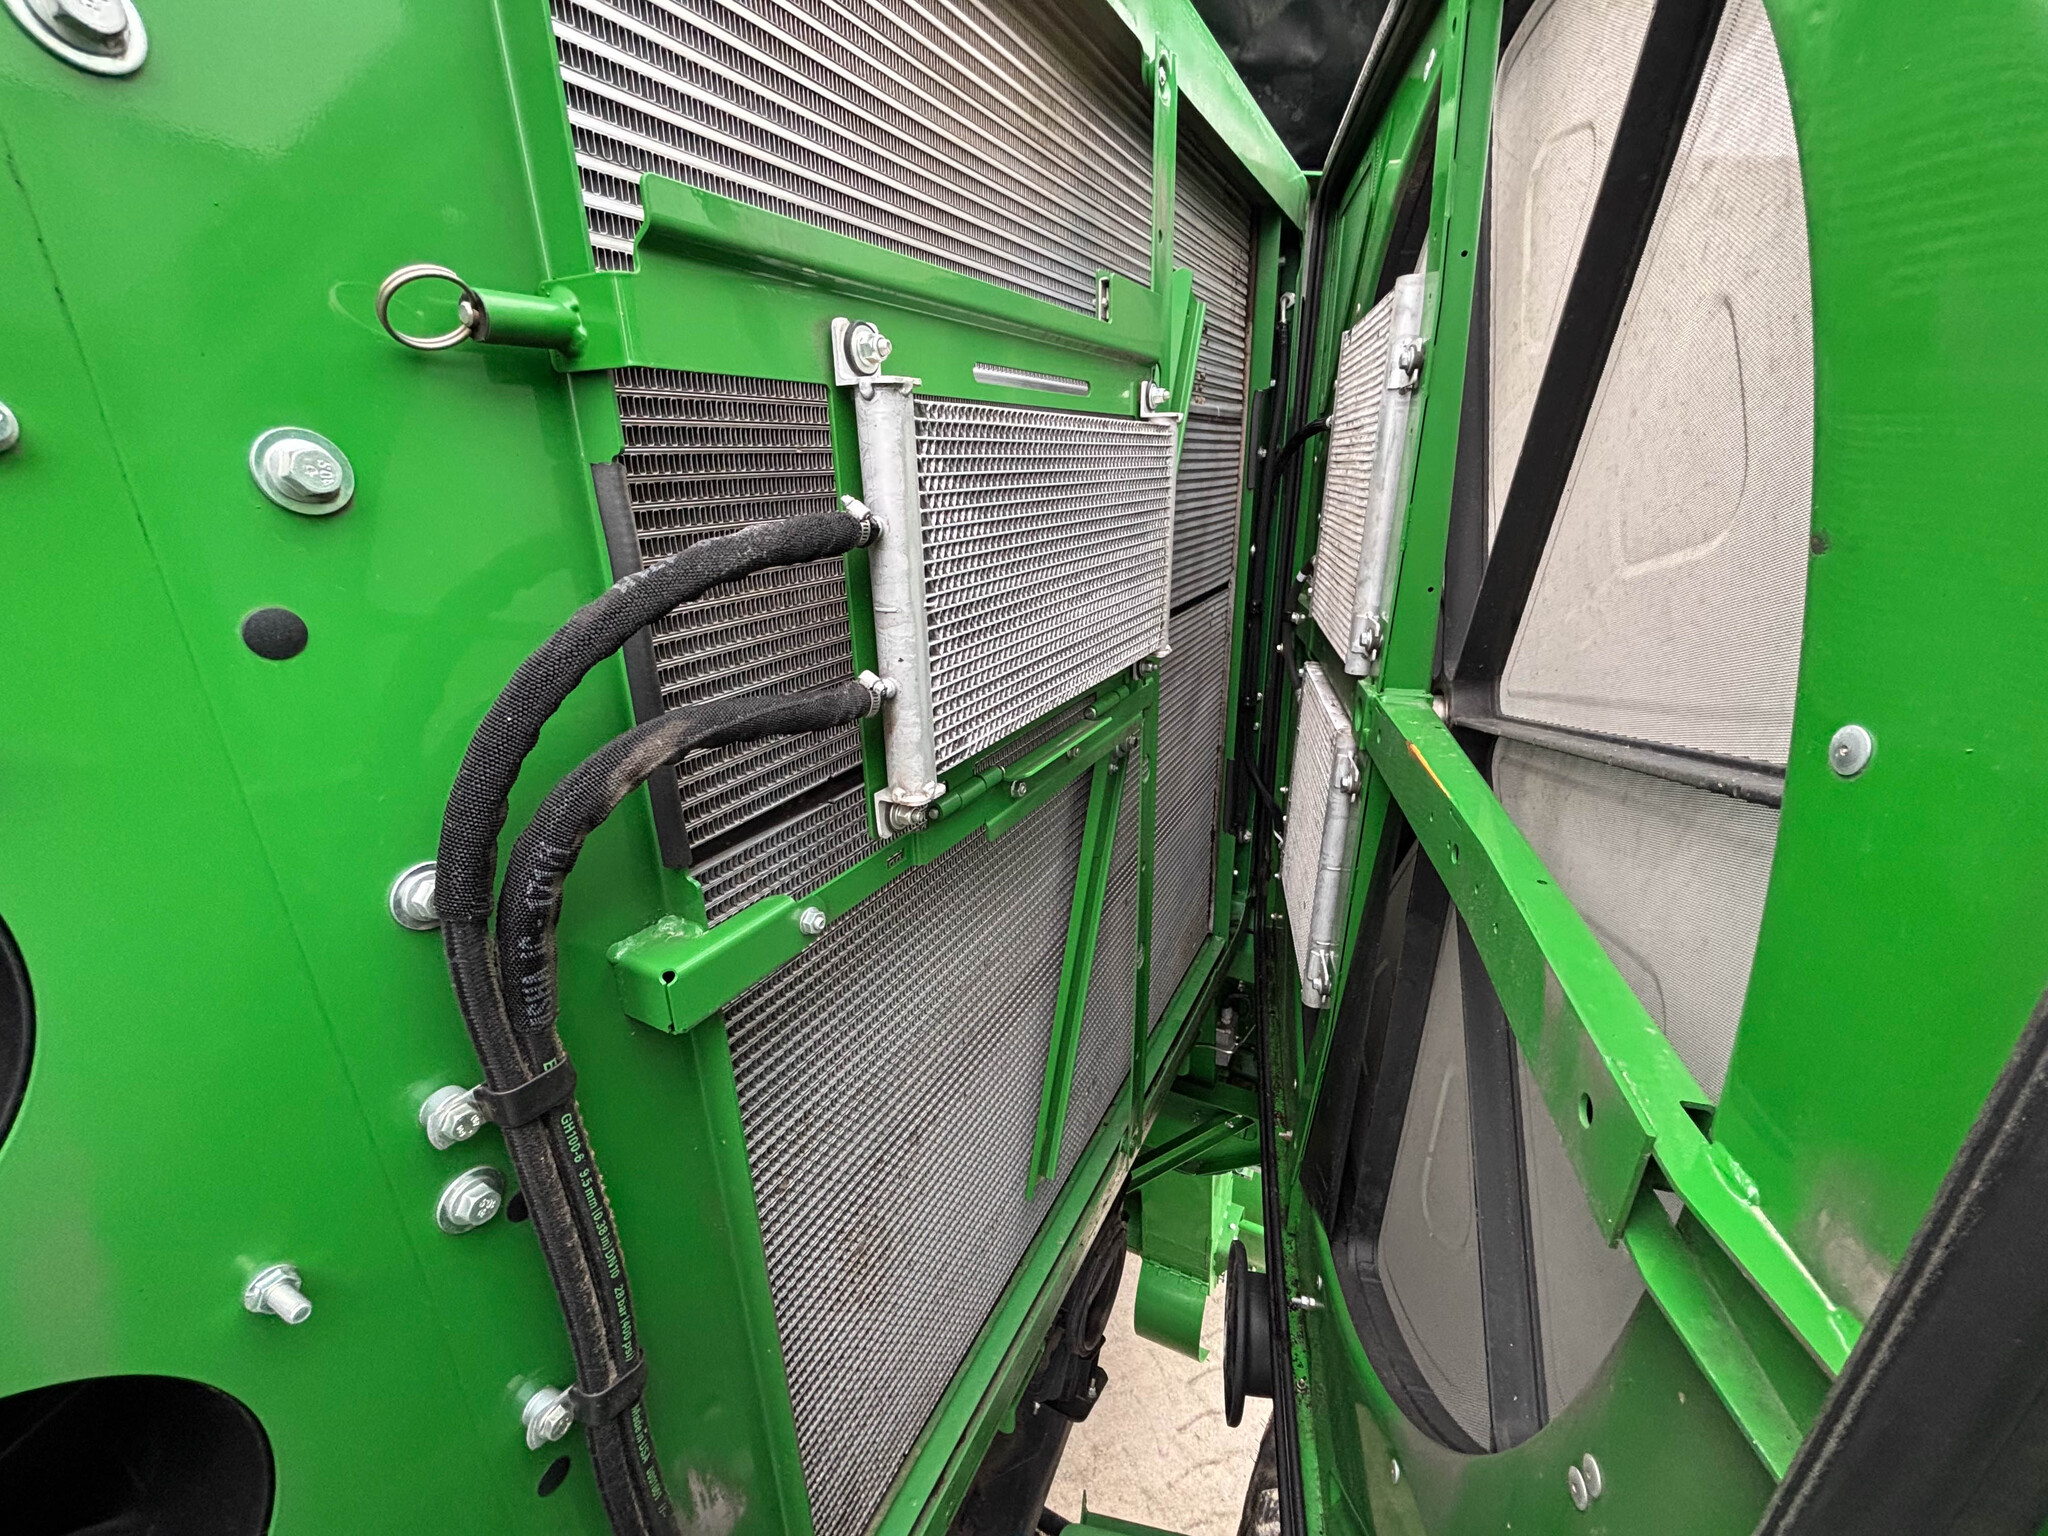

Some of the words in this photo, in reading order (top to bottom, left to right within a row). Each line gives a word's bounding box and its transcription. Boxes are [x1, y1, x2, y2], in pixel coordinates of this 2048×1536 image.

[561, 1112, 585, 1164] GH100-6
[578, 1168, 593, 1188] 9.5
[585, 1189, 599, 1211] mm
[603, 1249, 620, 1279] DN10
[613, 1284, 624, 1299] 28
[615, 1297, 628, 1319] bar
[631, 1404, 643, 1431] Made
[638, 1437, 650, 1464] USA
